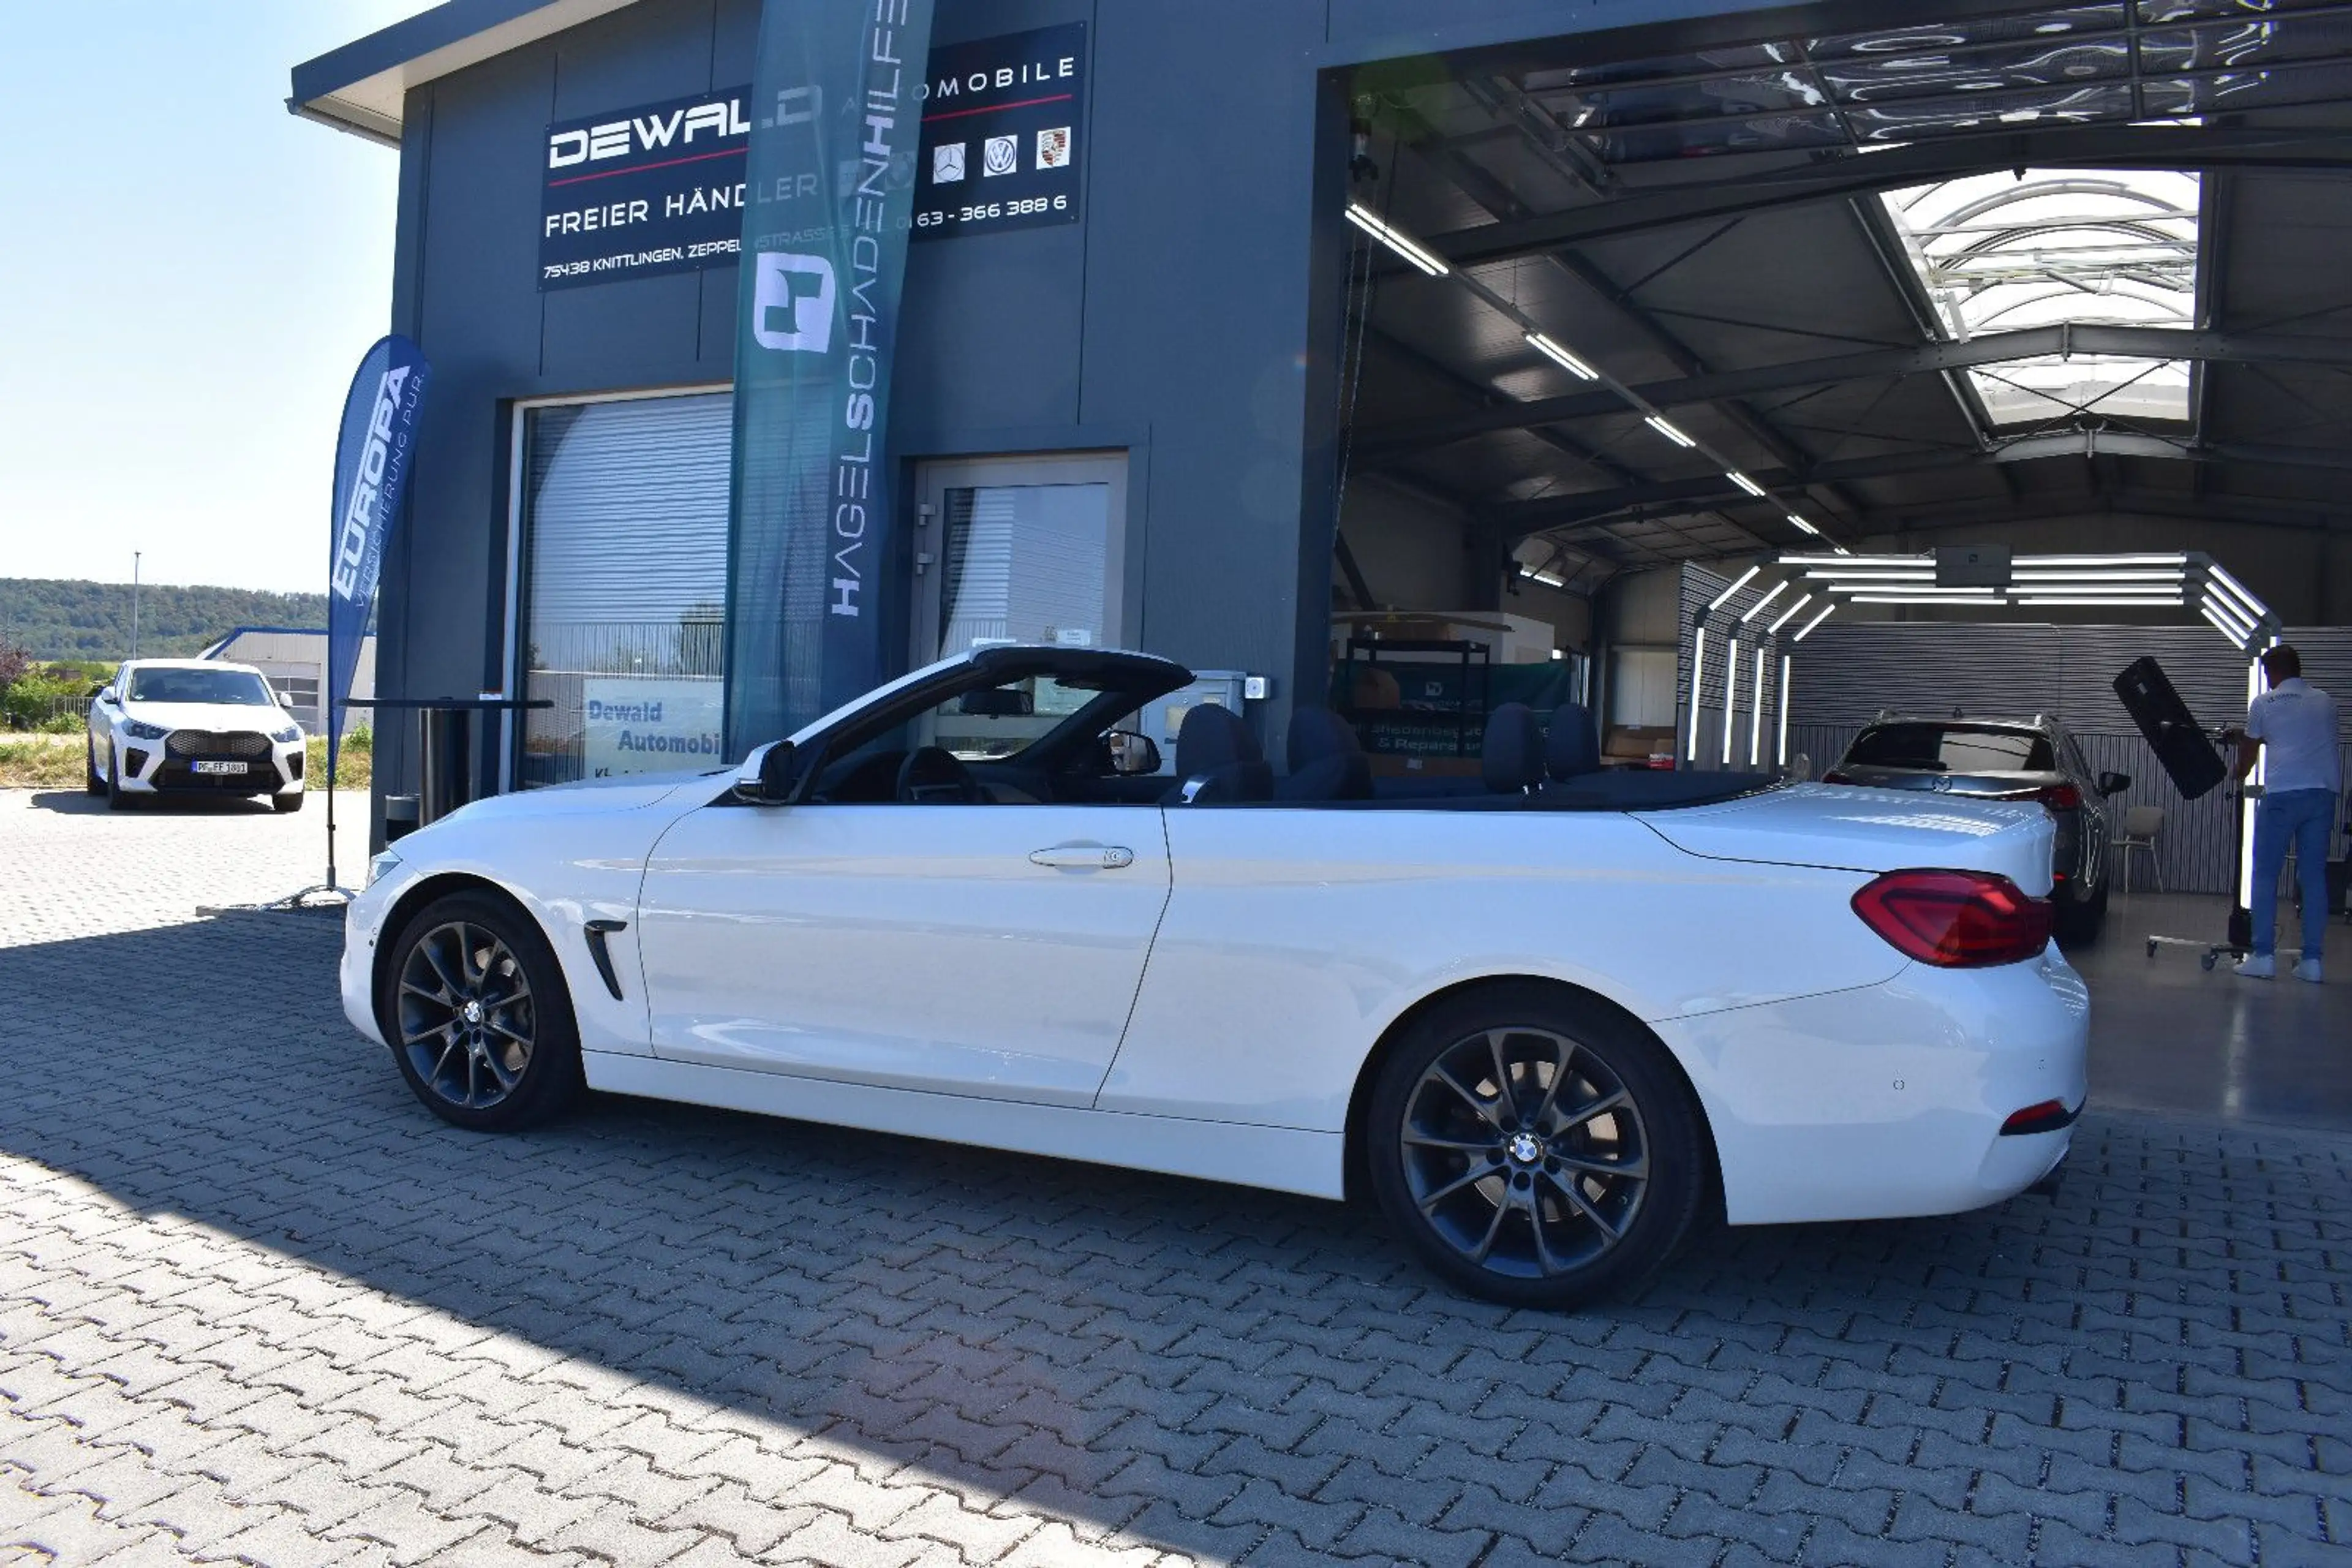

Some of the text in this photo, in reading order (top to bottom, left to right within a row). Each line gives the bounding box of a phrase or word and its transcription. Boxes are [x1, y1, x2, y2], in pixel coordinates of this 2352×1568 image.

[549, 85, 823, 168] DEWALD
[543, 260, 590, 279] 75438
[959, 204, 1001, 221] 366
[1006, 197, 1048, 216] 388
[1053, 195, 1068, 210] 6
[546, 172, 818, 238] FREIER HÄNDLER
[331, 365, 411, 601] EUROPA
[589, 699, 662, 722] Dewald
